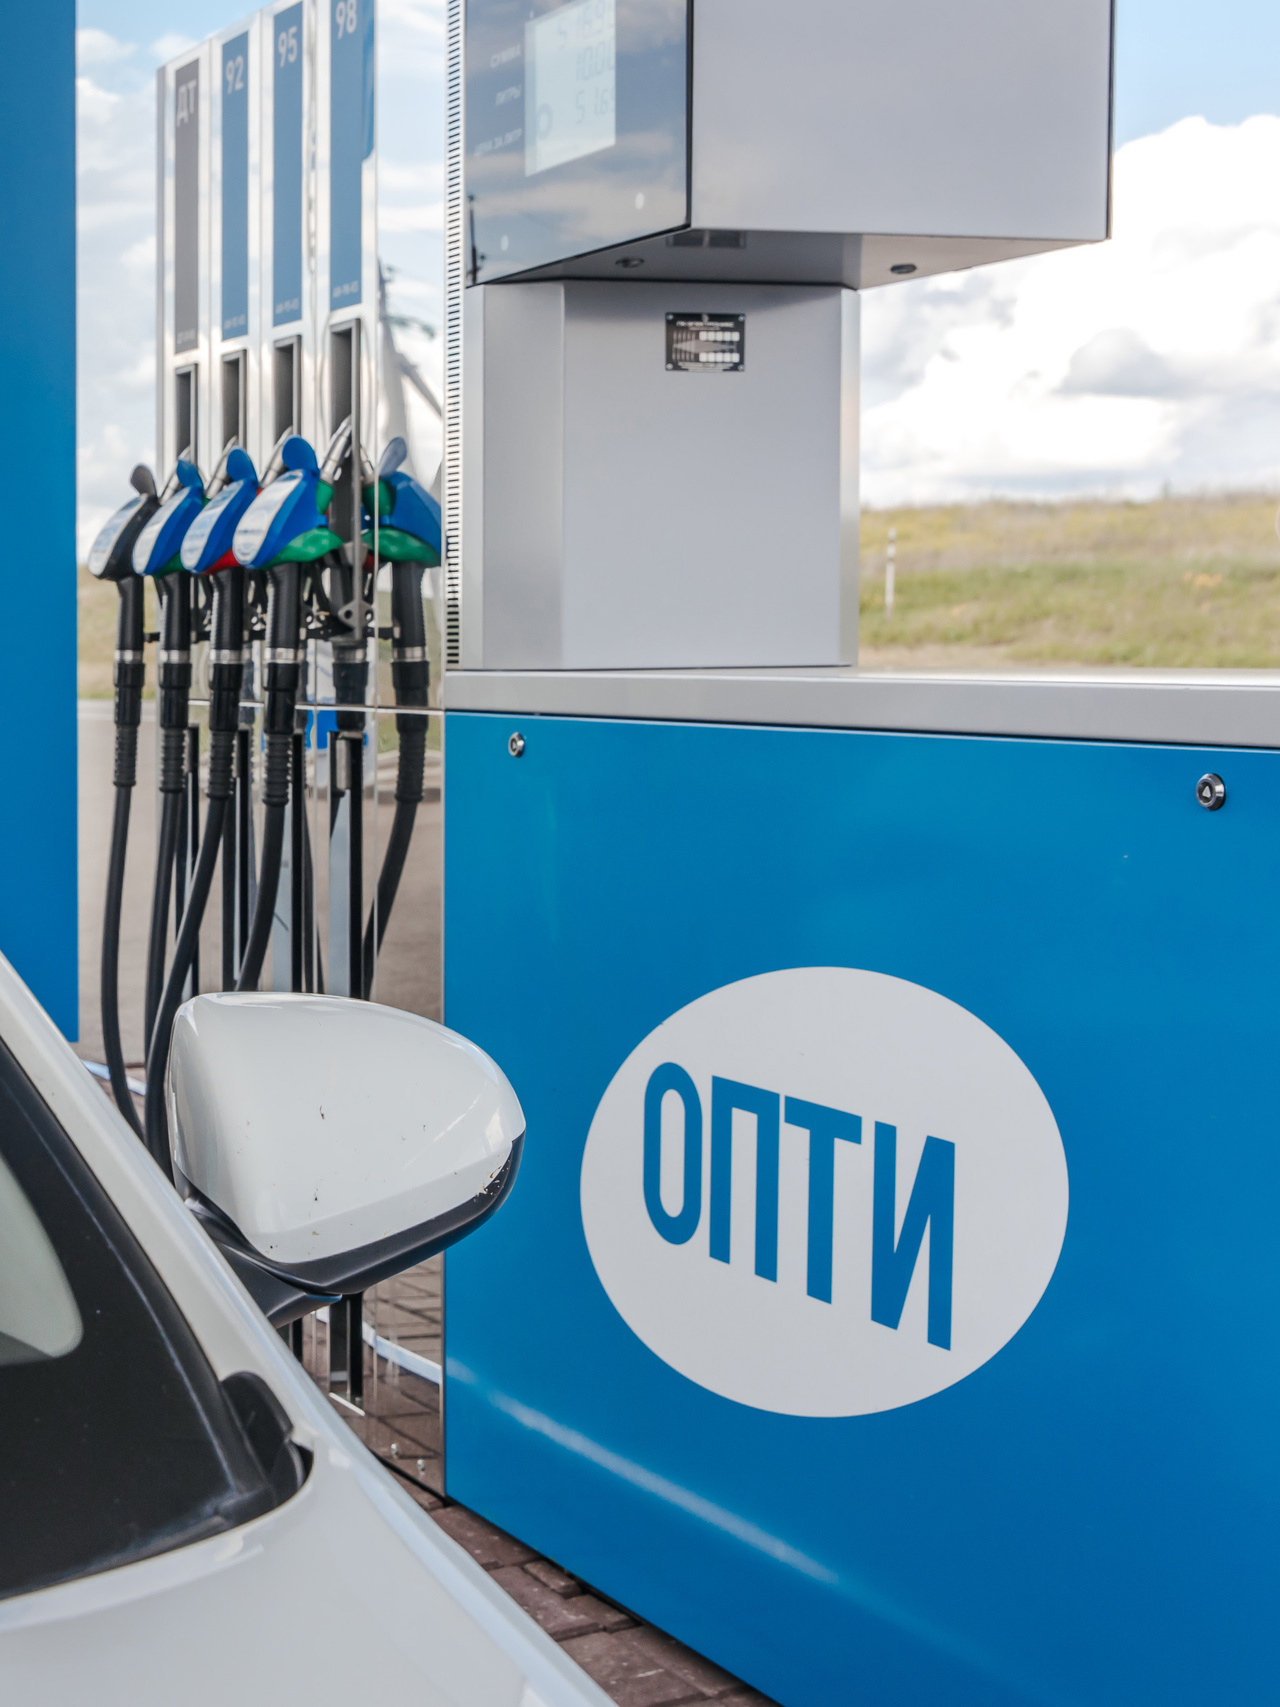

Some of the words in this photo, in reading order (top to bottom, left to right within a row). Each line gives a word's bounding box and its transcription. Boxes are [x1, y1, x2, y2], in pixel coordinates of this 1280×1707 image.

[335, 0, 357, 39] 98
[278, 25, 298, 68] 95
[225, 55, 245, 94] 92
[176, 79, 197, 127] ДТ
[643, 1061, 956, 1352] ОПТИ
